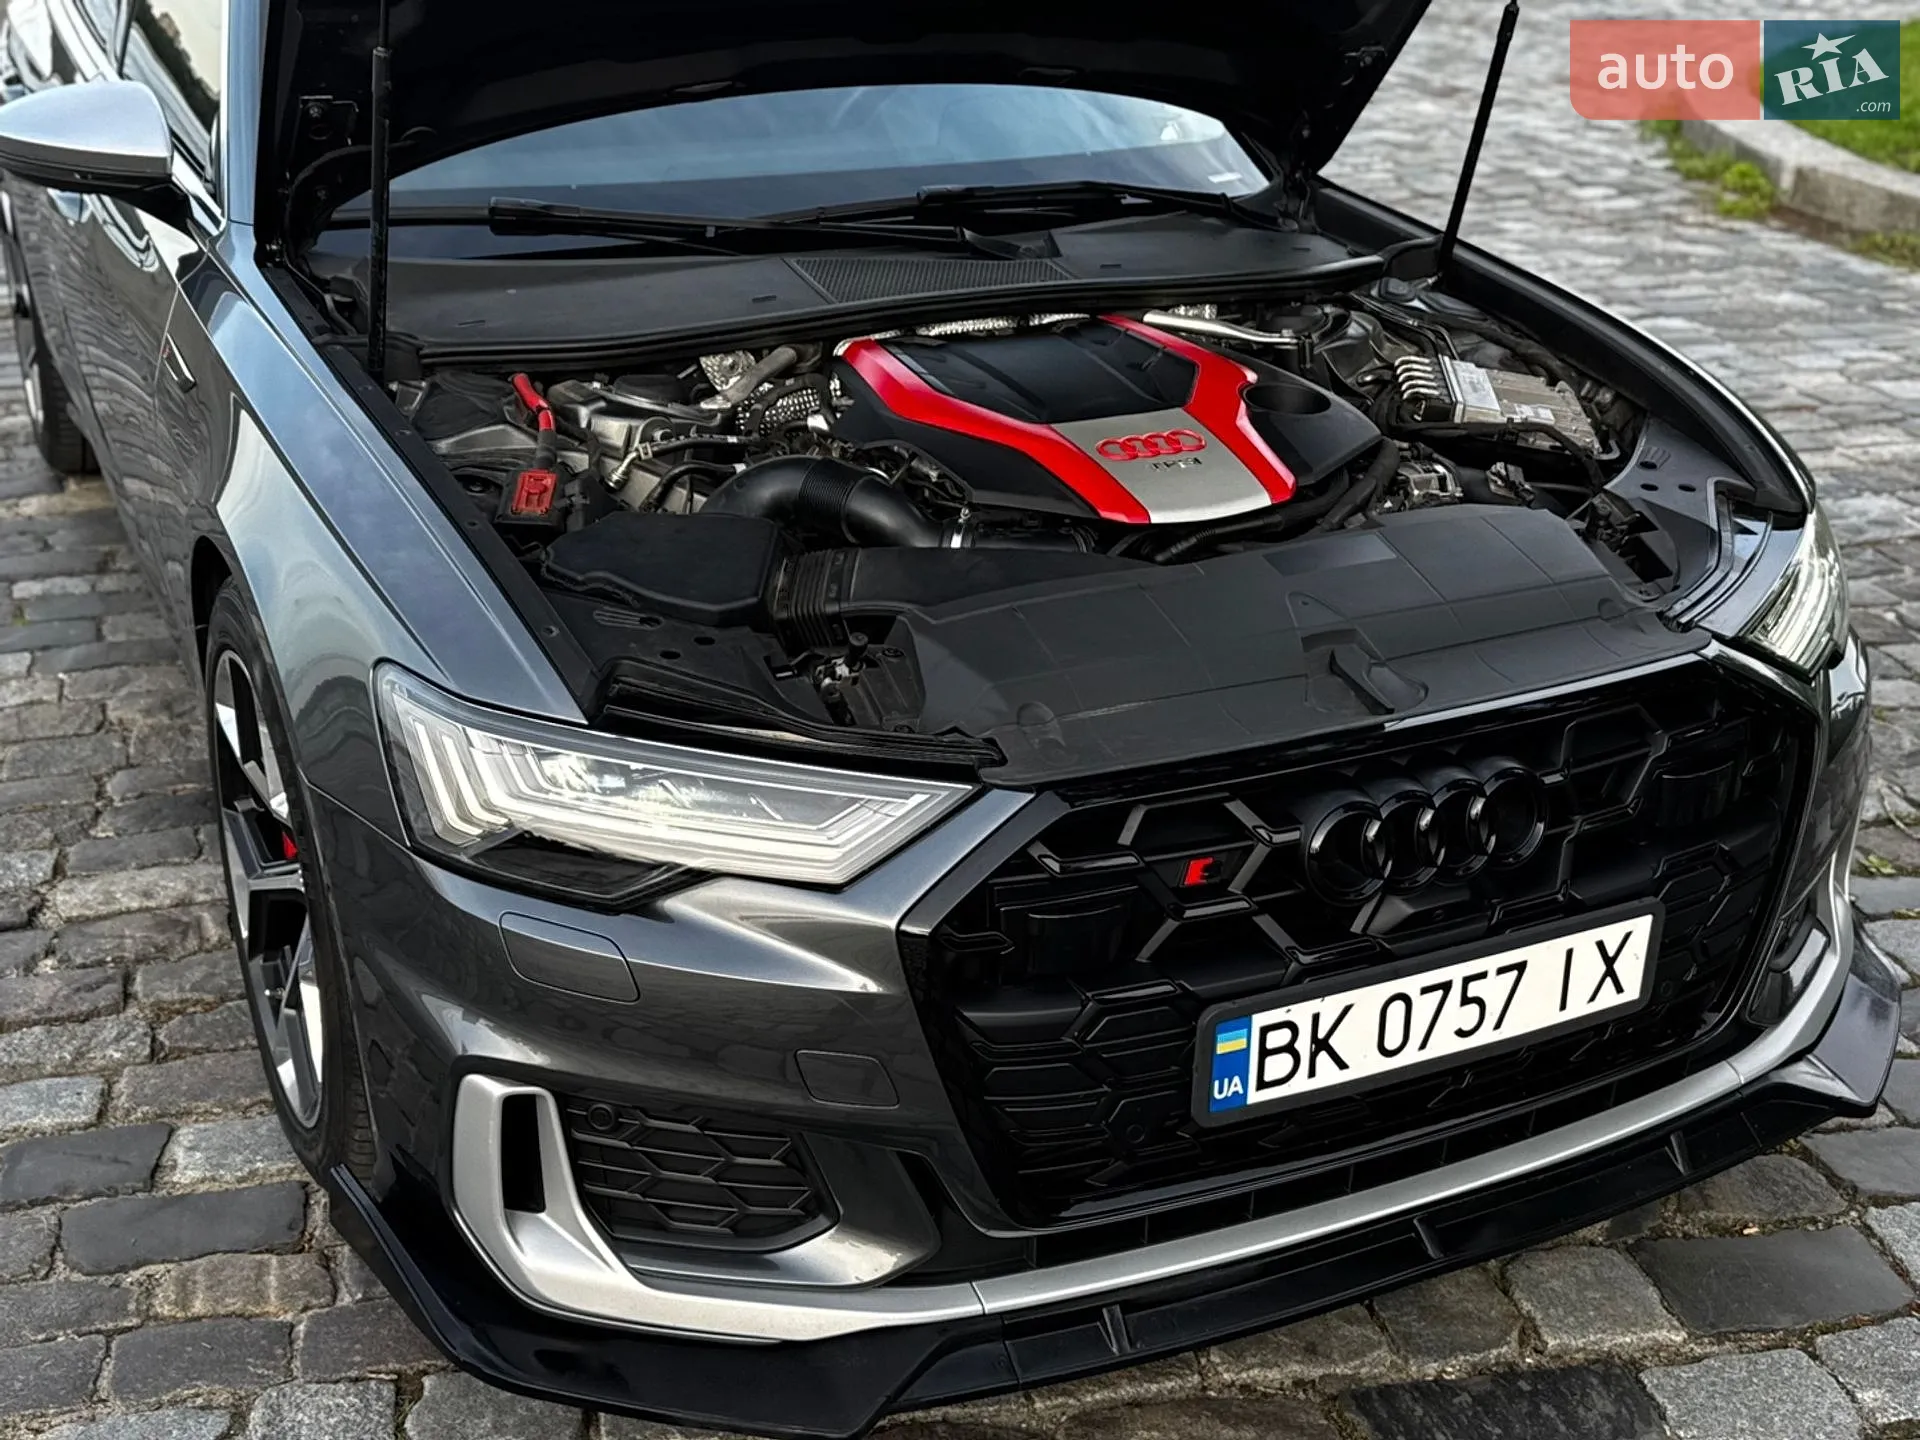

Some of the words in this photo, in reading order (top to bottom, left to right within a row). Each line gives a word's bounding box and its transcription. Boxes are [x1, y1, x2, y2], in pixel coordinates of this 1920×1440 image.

[1255, 1002, 1355, 1092] BK
[1376, 960, 1529, 1059] 0757
[1213, 1074, 1244, 1100] UA
